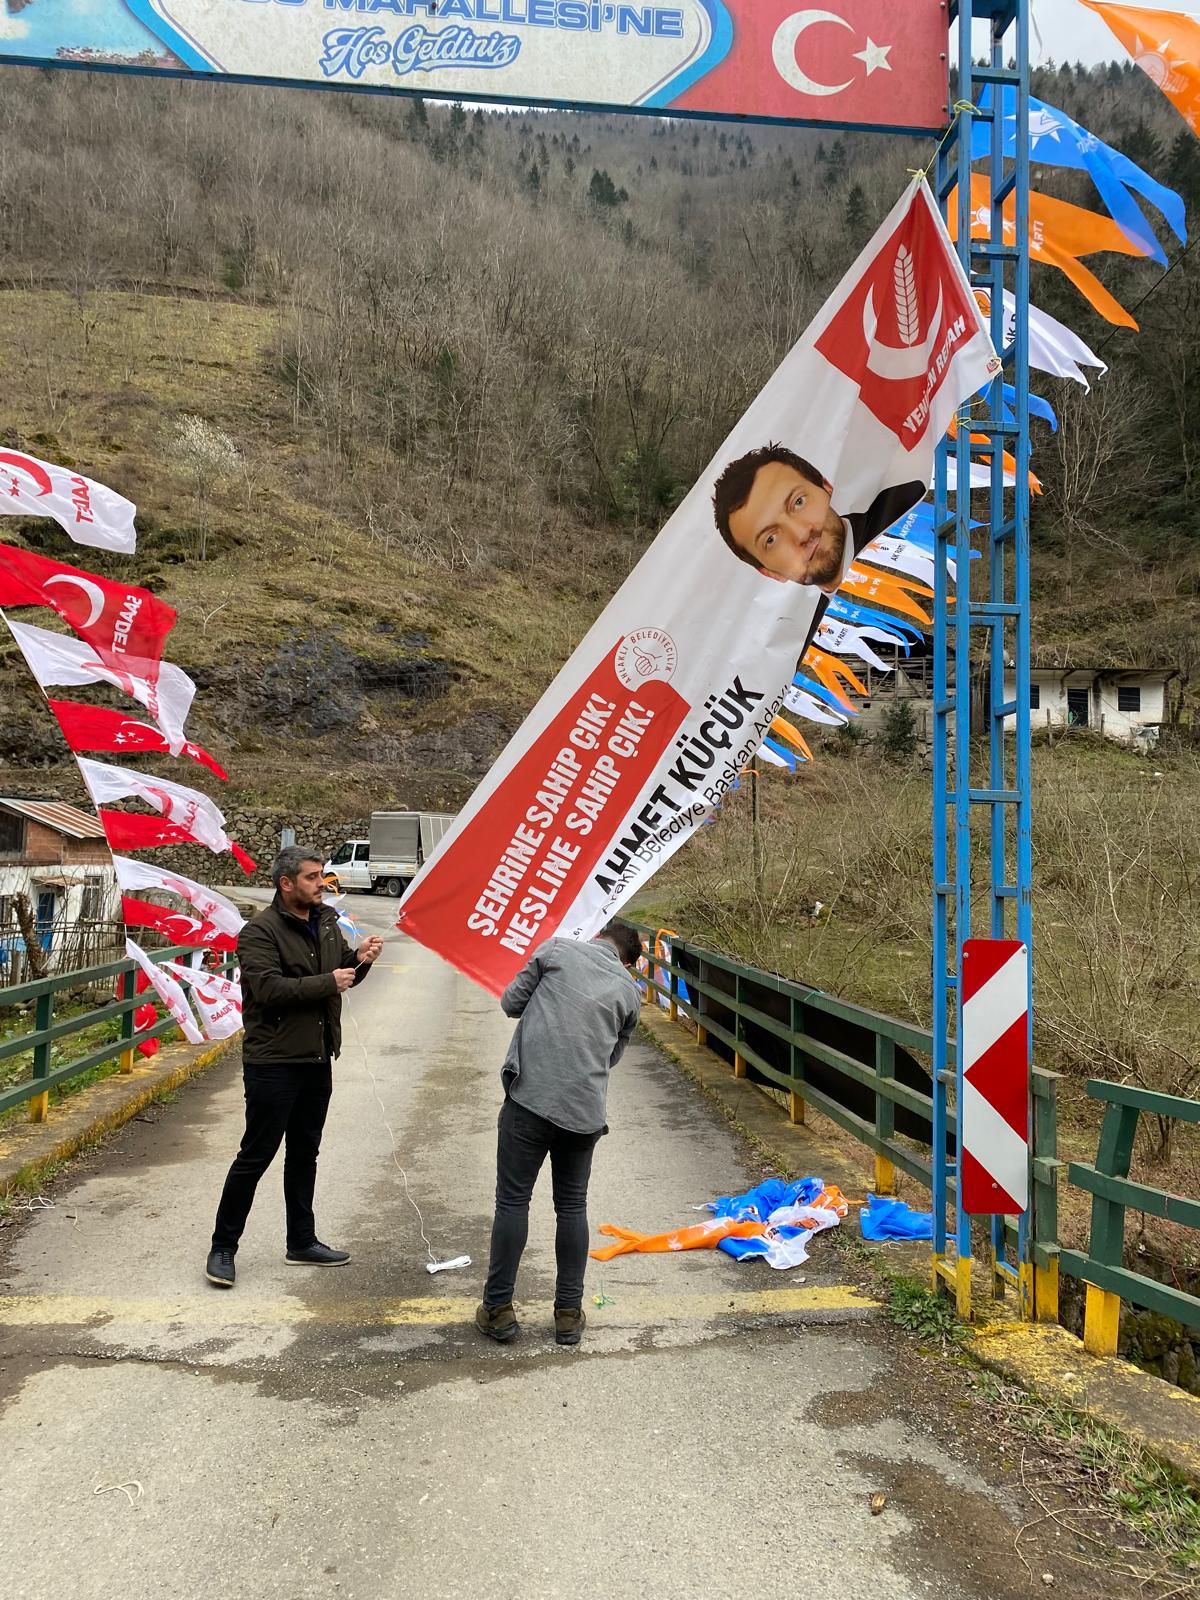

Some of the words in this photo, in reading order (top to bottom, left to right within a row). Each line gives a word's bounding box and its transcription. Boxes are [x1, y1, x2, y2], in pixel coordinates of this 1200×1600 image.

[392, 24, 522, 76] Geldiniz
[569, 692, 617, 750] ÇIK!
[607, 700, 655, 758] ÇIK!
[667, 675, 765, 793] KÜÇÜK
[637, 801, 706, 864] Belediye
